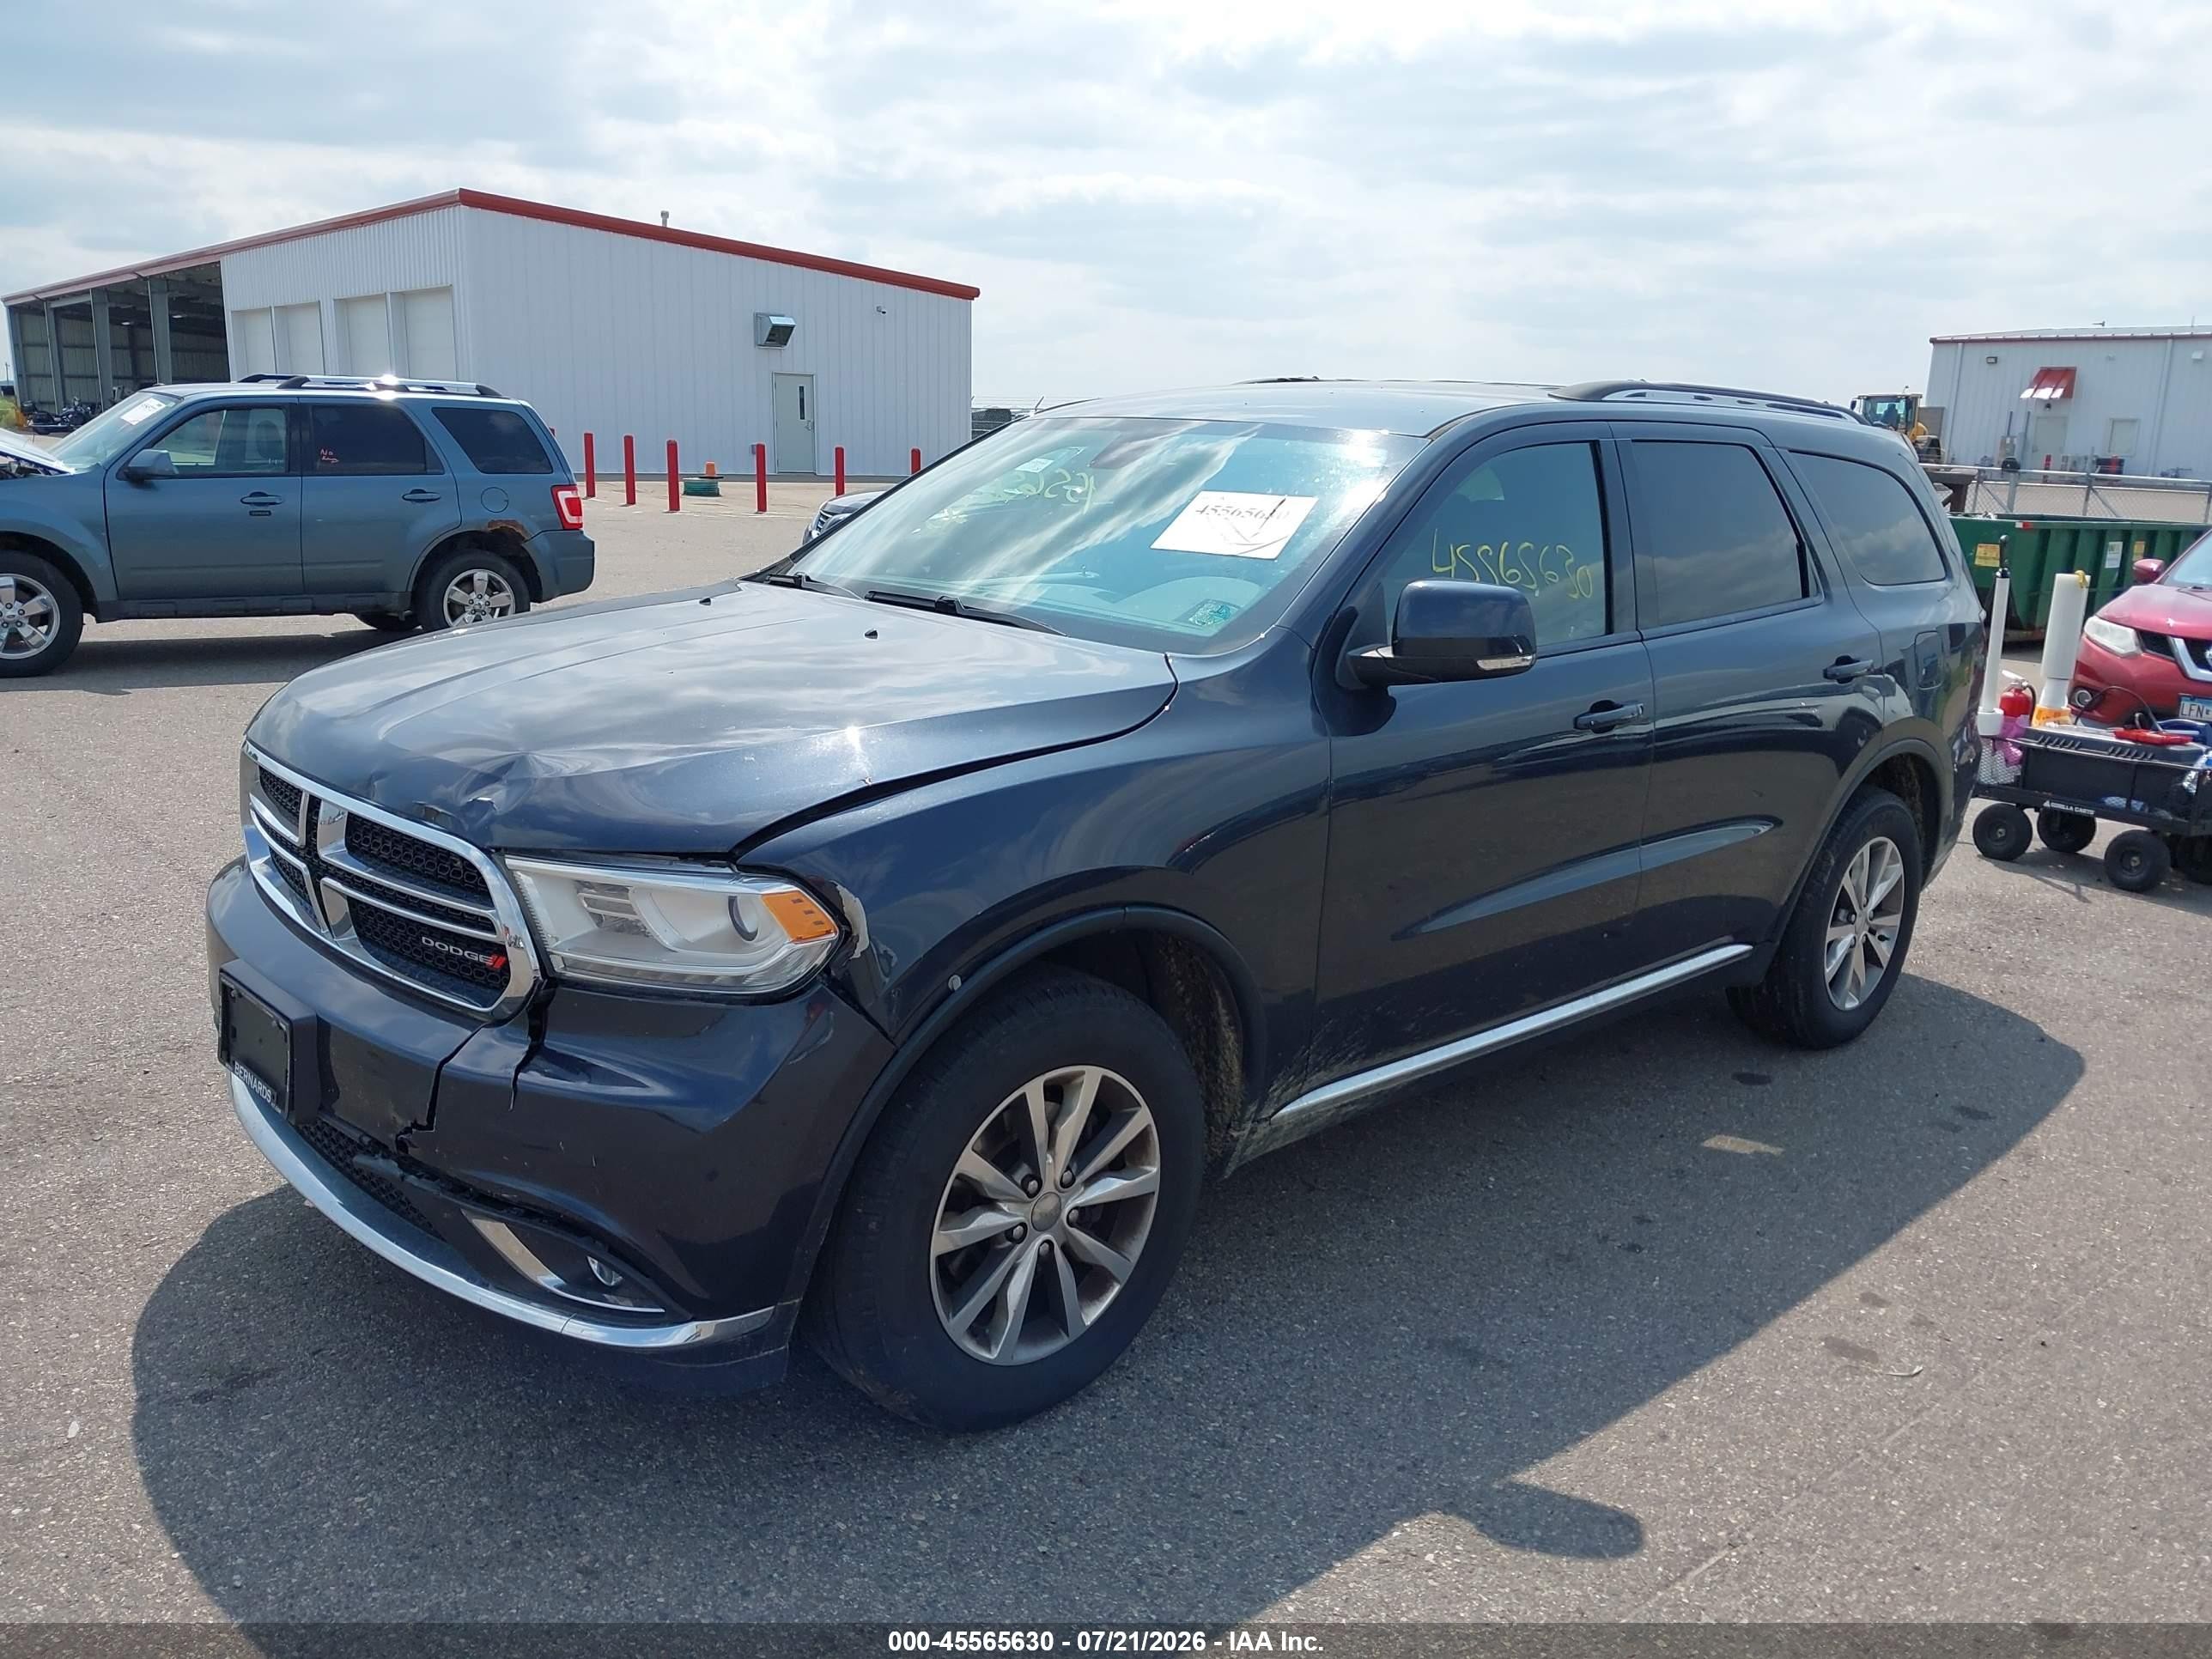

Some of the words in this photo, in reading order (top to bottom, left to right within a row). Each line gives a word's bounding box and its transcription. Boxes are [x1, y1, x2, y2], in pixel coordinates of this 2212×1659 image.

[1431, 528, 1593, 599] 45565630
[422, 936, 494, 965] DODGE
[234, 1060, 272, 1103] BERNARDS
